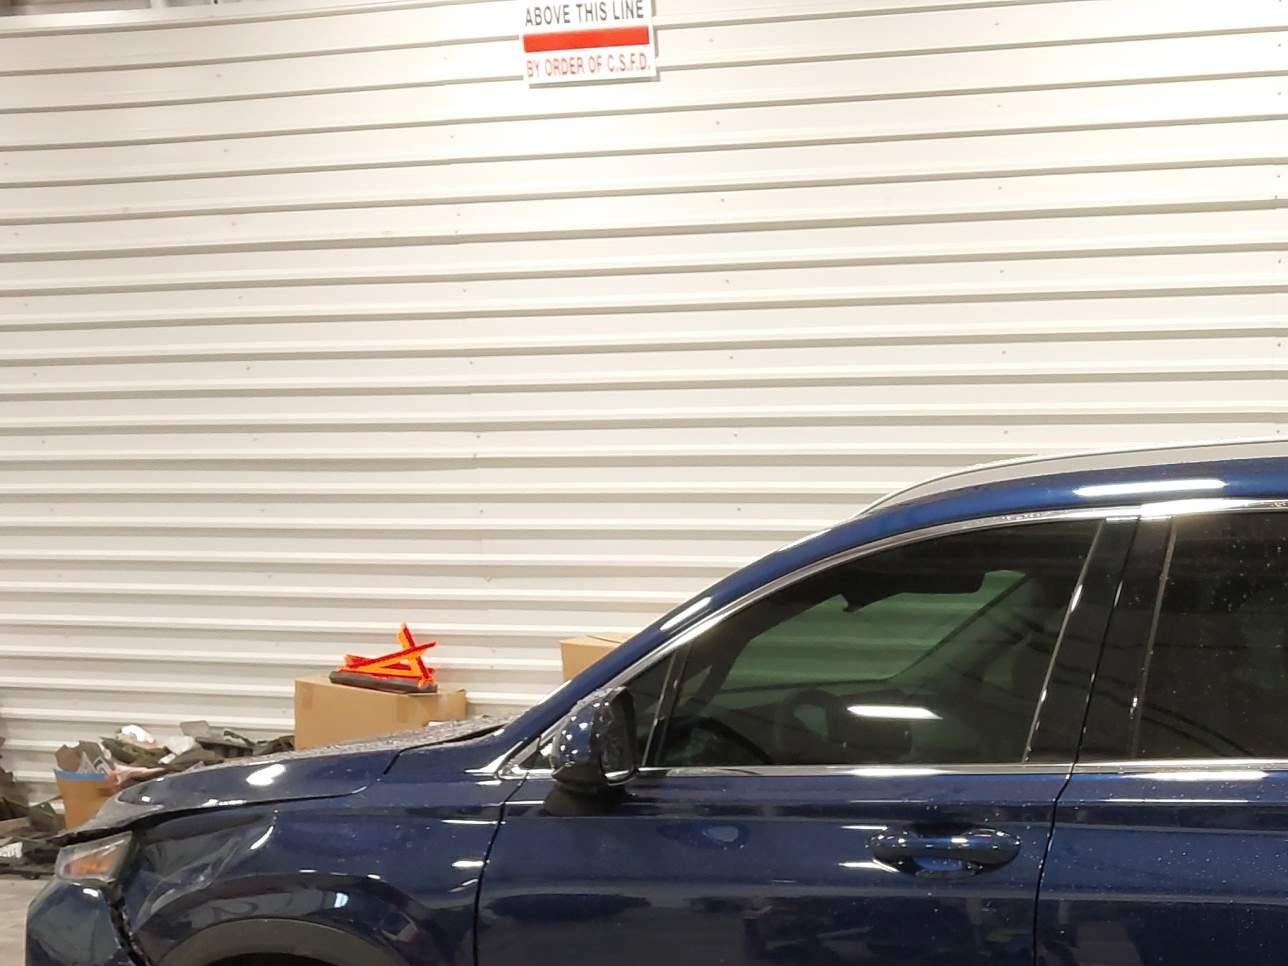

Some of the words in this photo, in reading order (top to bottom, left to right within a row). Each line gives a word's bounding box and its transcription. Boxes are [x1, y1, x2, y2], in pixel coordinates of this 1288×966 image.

[525, 5, 571, 26] ABOVE
[576, 2, 607, 22] THIS
[613, 0, 644, 19] LINE
[527, 60, 540, 77] BY
[545, 57, 584, 76] ORDER
[588, 55, 602, 73] OF
